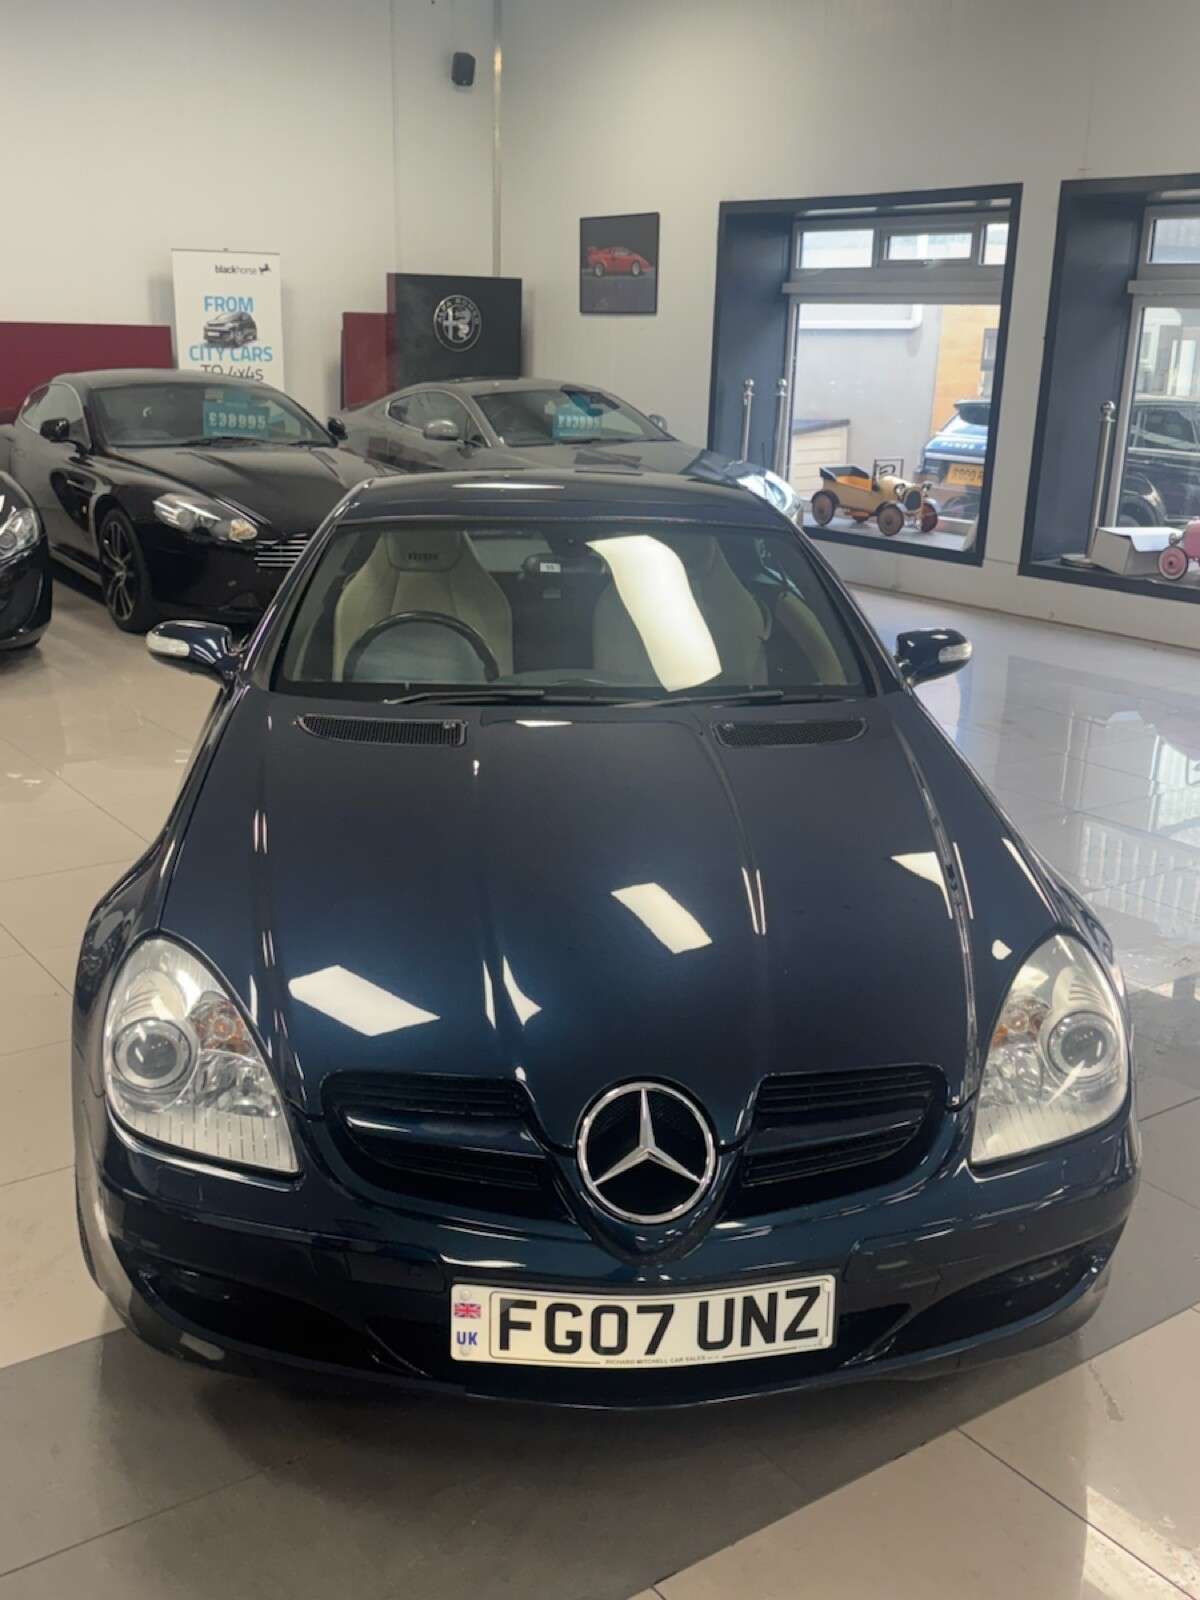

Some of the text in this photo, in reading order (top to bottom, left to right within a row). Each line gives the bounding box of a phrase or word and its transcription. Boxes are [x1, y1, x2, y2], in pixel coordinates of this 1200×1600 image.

[204, 295, 254, 313] FROM
[189, 343, 273, 362] CITY CARS
[200, 363, 224, 375] TO
[499, 1285, 821, 1357] FG07 UNZ
[456, 1331, 478, 1346] UK
